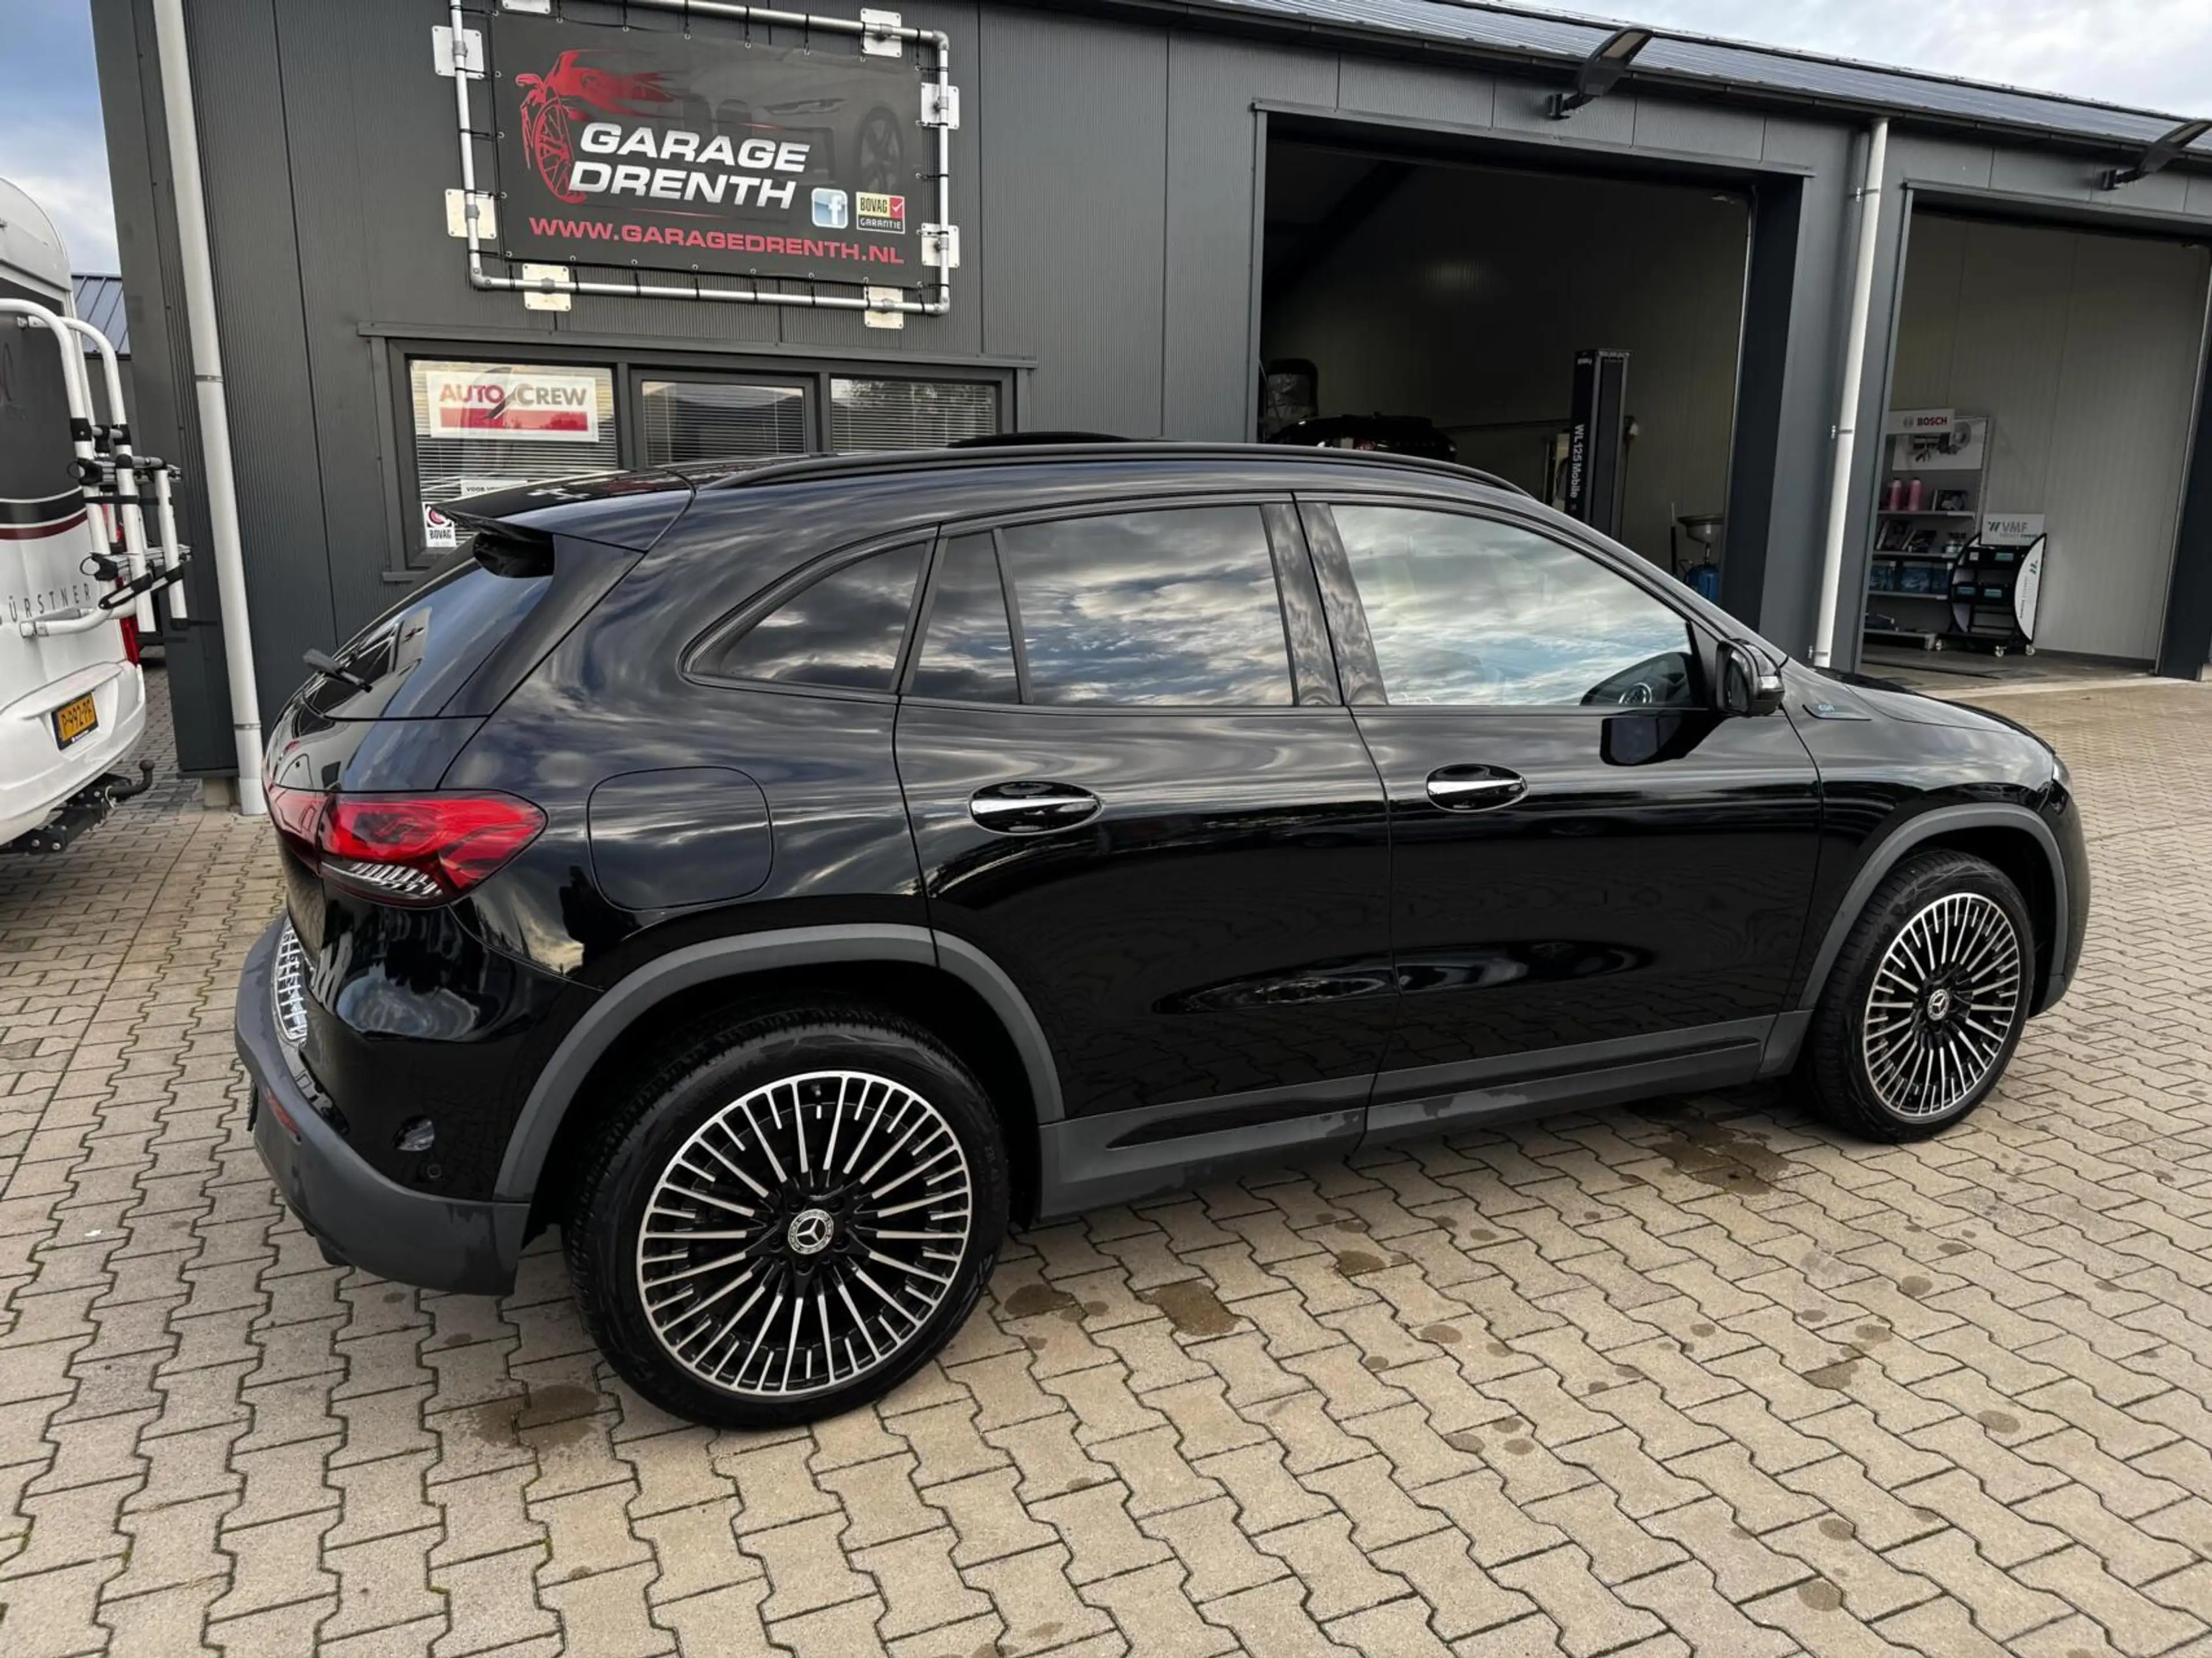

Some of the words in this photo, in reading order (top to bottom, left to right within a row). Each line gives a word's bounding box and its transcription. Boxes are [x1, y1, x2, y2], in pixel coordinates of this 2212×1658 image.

[581, 123, 810, 173] GARAGE
[569, 162, 796, 210] DRENTH
[860, 197, 888, 214] BOVAG
[860, 217, 902, 229] GARANTIE
[529, 217, 904, 265] WWW.GARAGEDRENTH.NL
[440, 383, 505, 404] AUTO
[517, 383, 587, 405] CREW
[1917, 416, 1948, 426] BOSCH
[2002, 521, 2028, 533] VMF
[0, 583, 91, 625] ÜRSTNER
